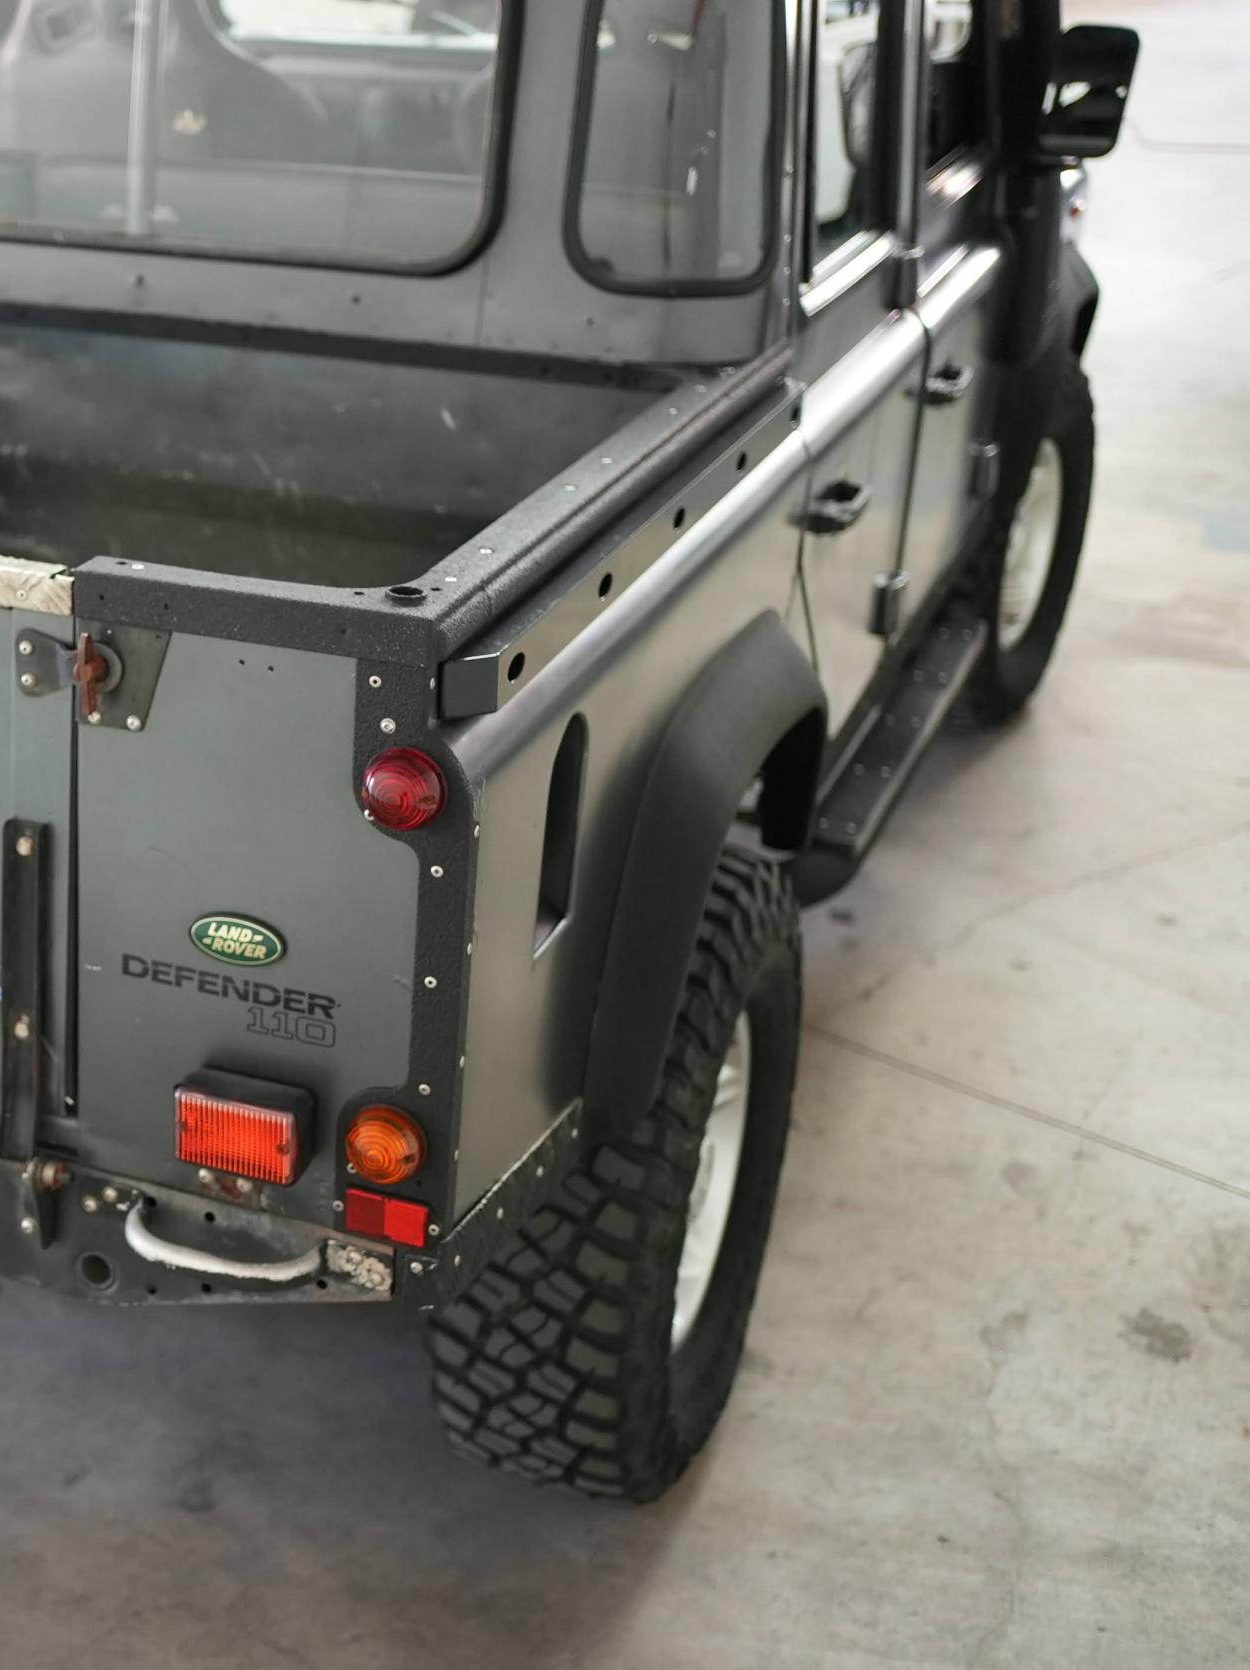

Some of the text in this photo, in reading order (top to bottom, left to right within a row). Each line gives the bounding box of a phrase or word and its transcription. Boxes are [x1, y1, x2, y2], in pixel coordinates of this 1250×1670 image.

[207, 921, 253, 942] LAND
[211, 937, 267, 959] ROVER
[121, 953, 337, 1019] DEFENDER
[246, 1006, 337, 1048] 110
